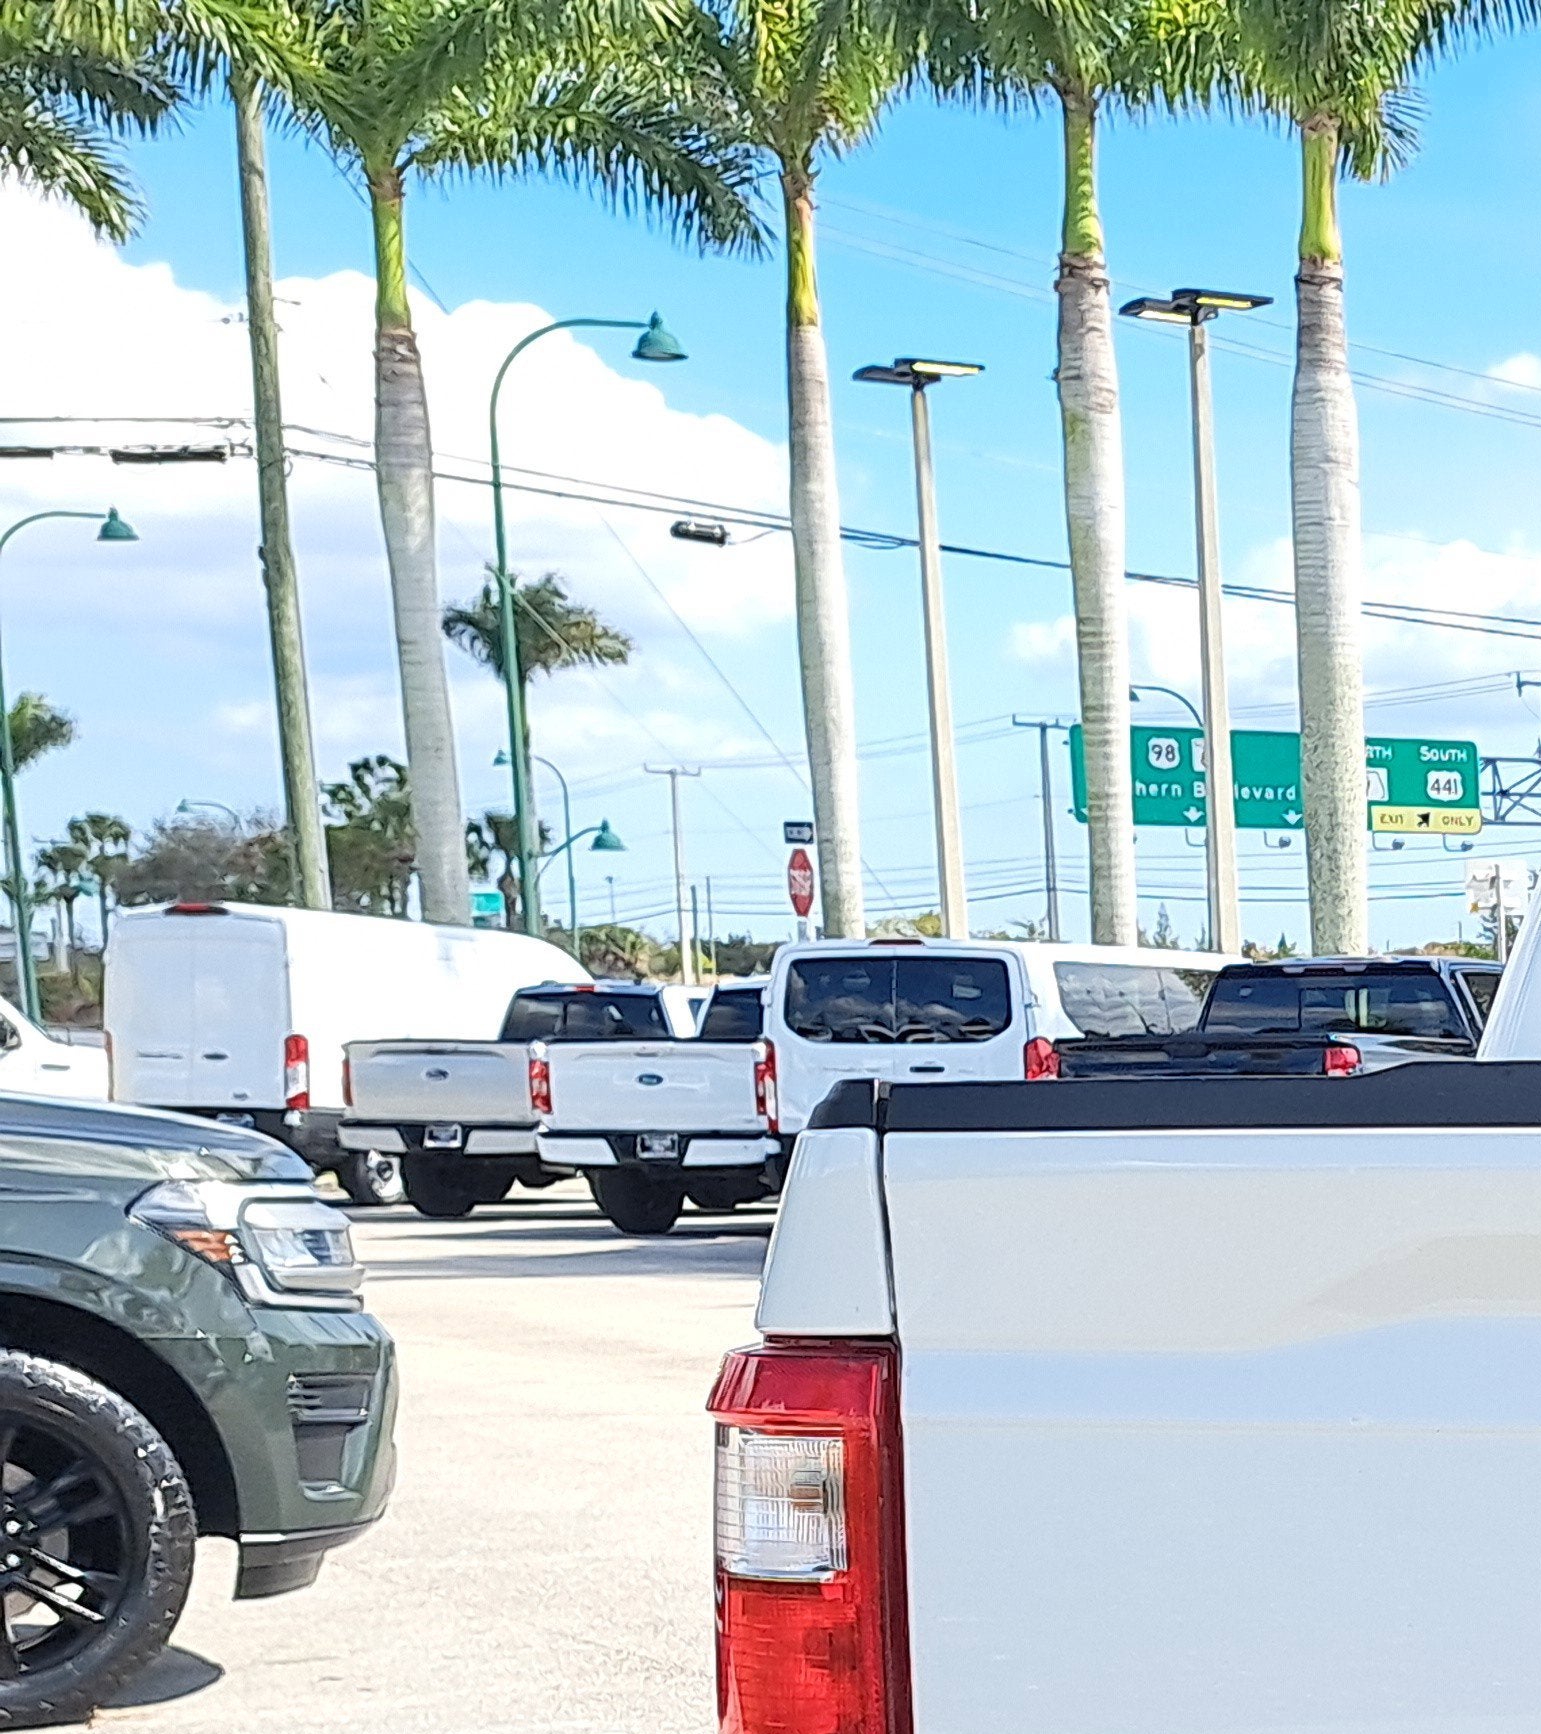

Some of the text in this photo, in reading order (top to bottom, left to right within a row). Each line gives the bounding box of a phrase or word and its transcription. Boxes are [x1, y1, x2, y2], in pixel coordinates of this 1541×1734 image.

[1151, 744, 1176, 762] 98
[1420, 746, 1467, 762] SOUTH
[1430, 778, 1458, 795] 441
